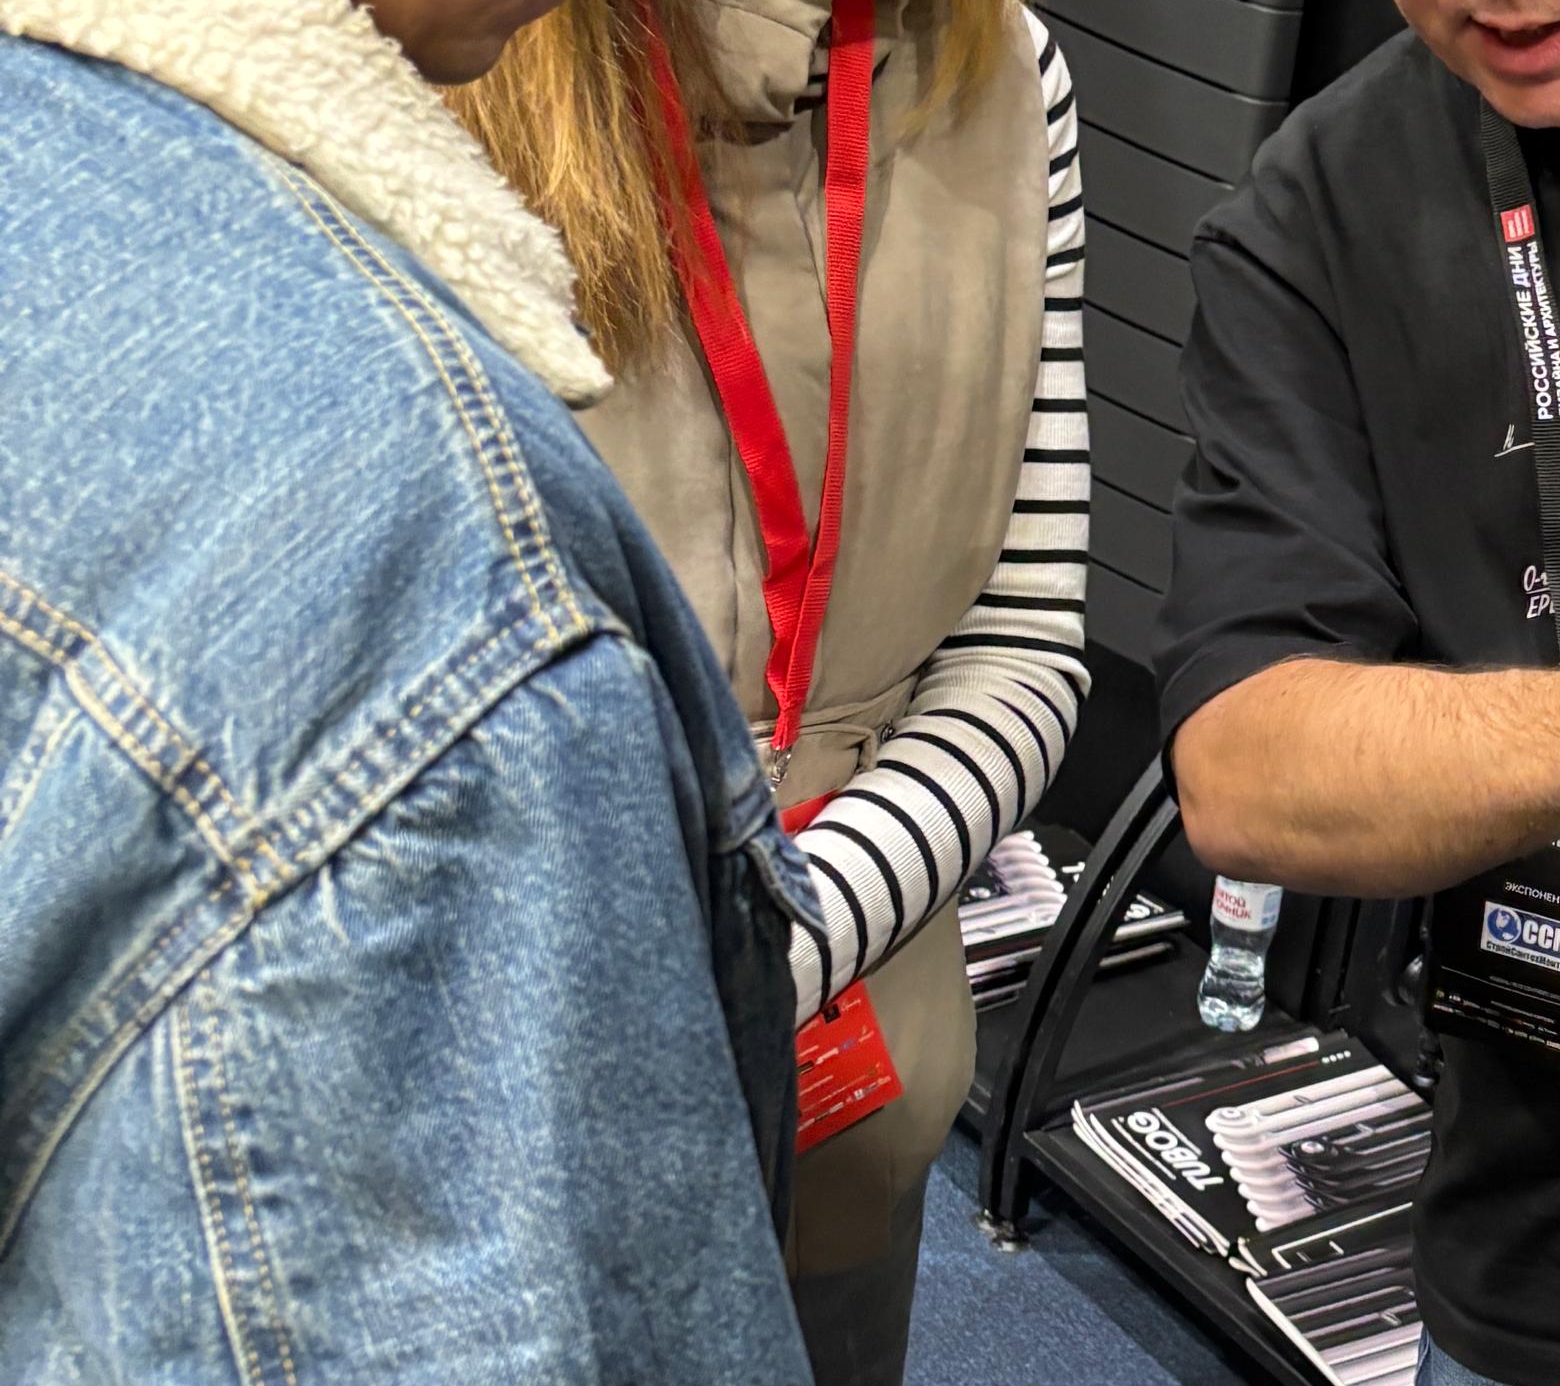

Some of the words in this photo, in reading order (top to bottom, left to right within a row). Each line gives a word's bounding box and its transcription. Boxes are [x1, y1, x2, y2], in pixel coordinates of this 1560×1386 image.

[1507, 246, 1532, 288] ДНИ
[1526, 241, 1559, 337] АРХИТЕКТУРЫ
[1516, 291, 1553, 420] РОССИЙСКИЕ
[1548, 339, 1558, 349] И
[1126, 1110, 1225, 1192] TUBOG
